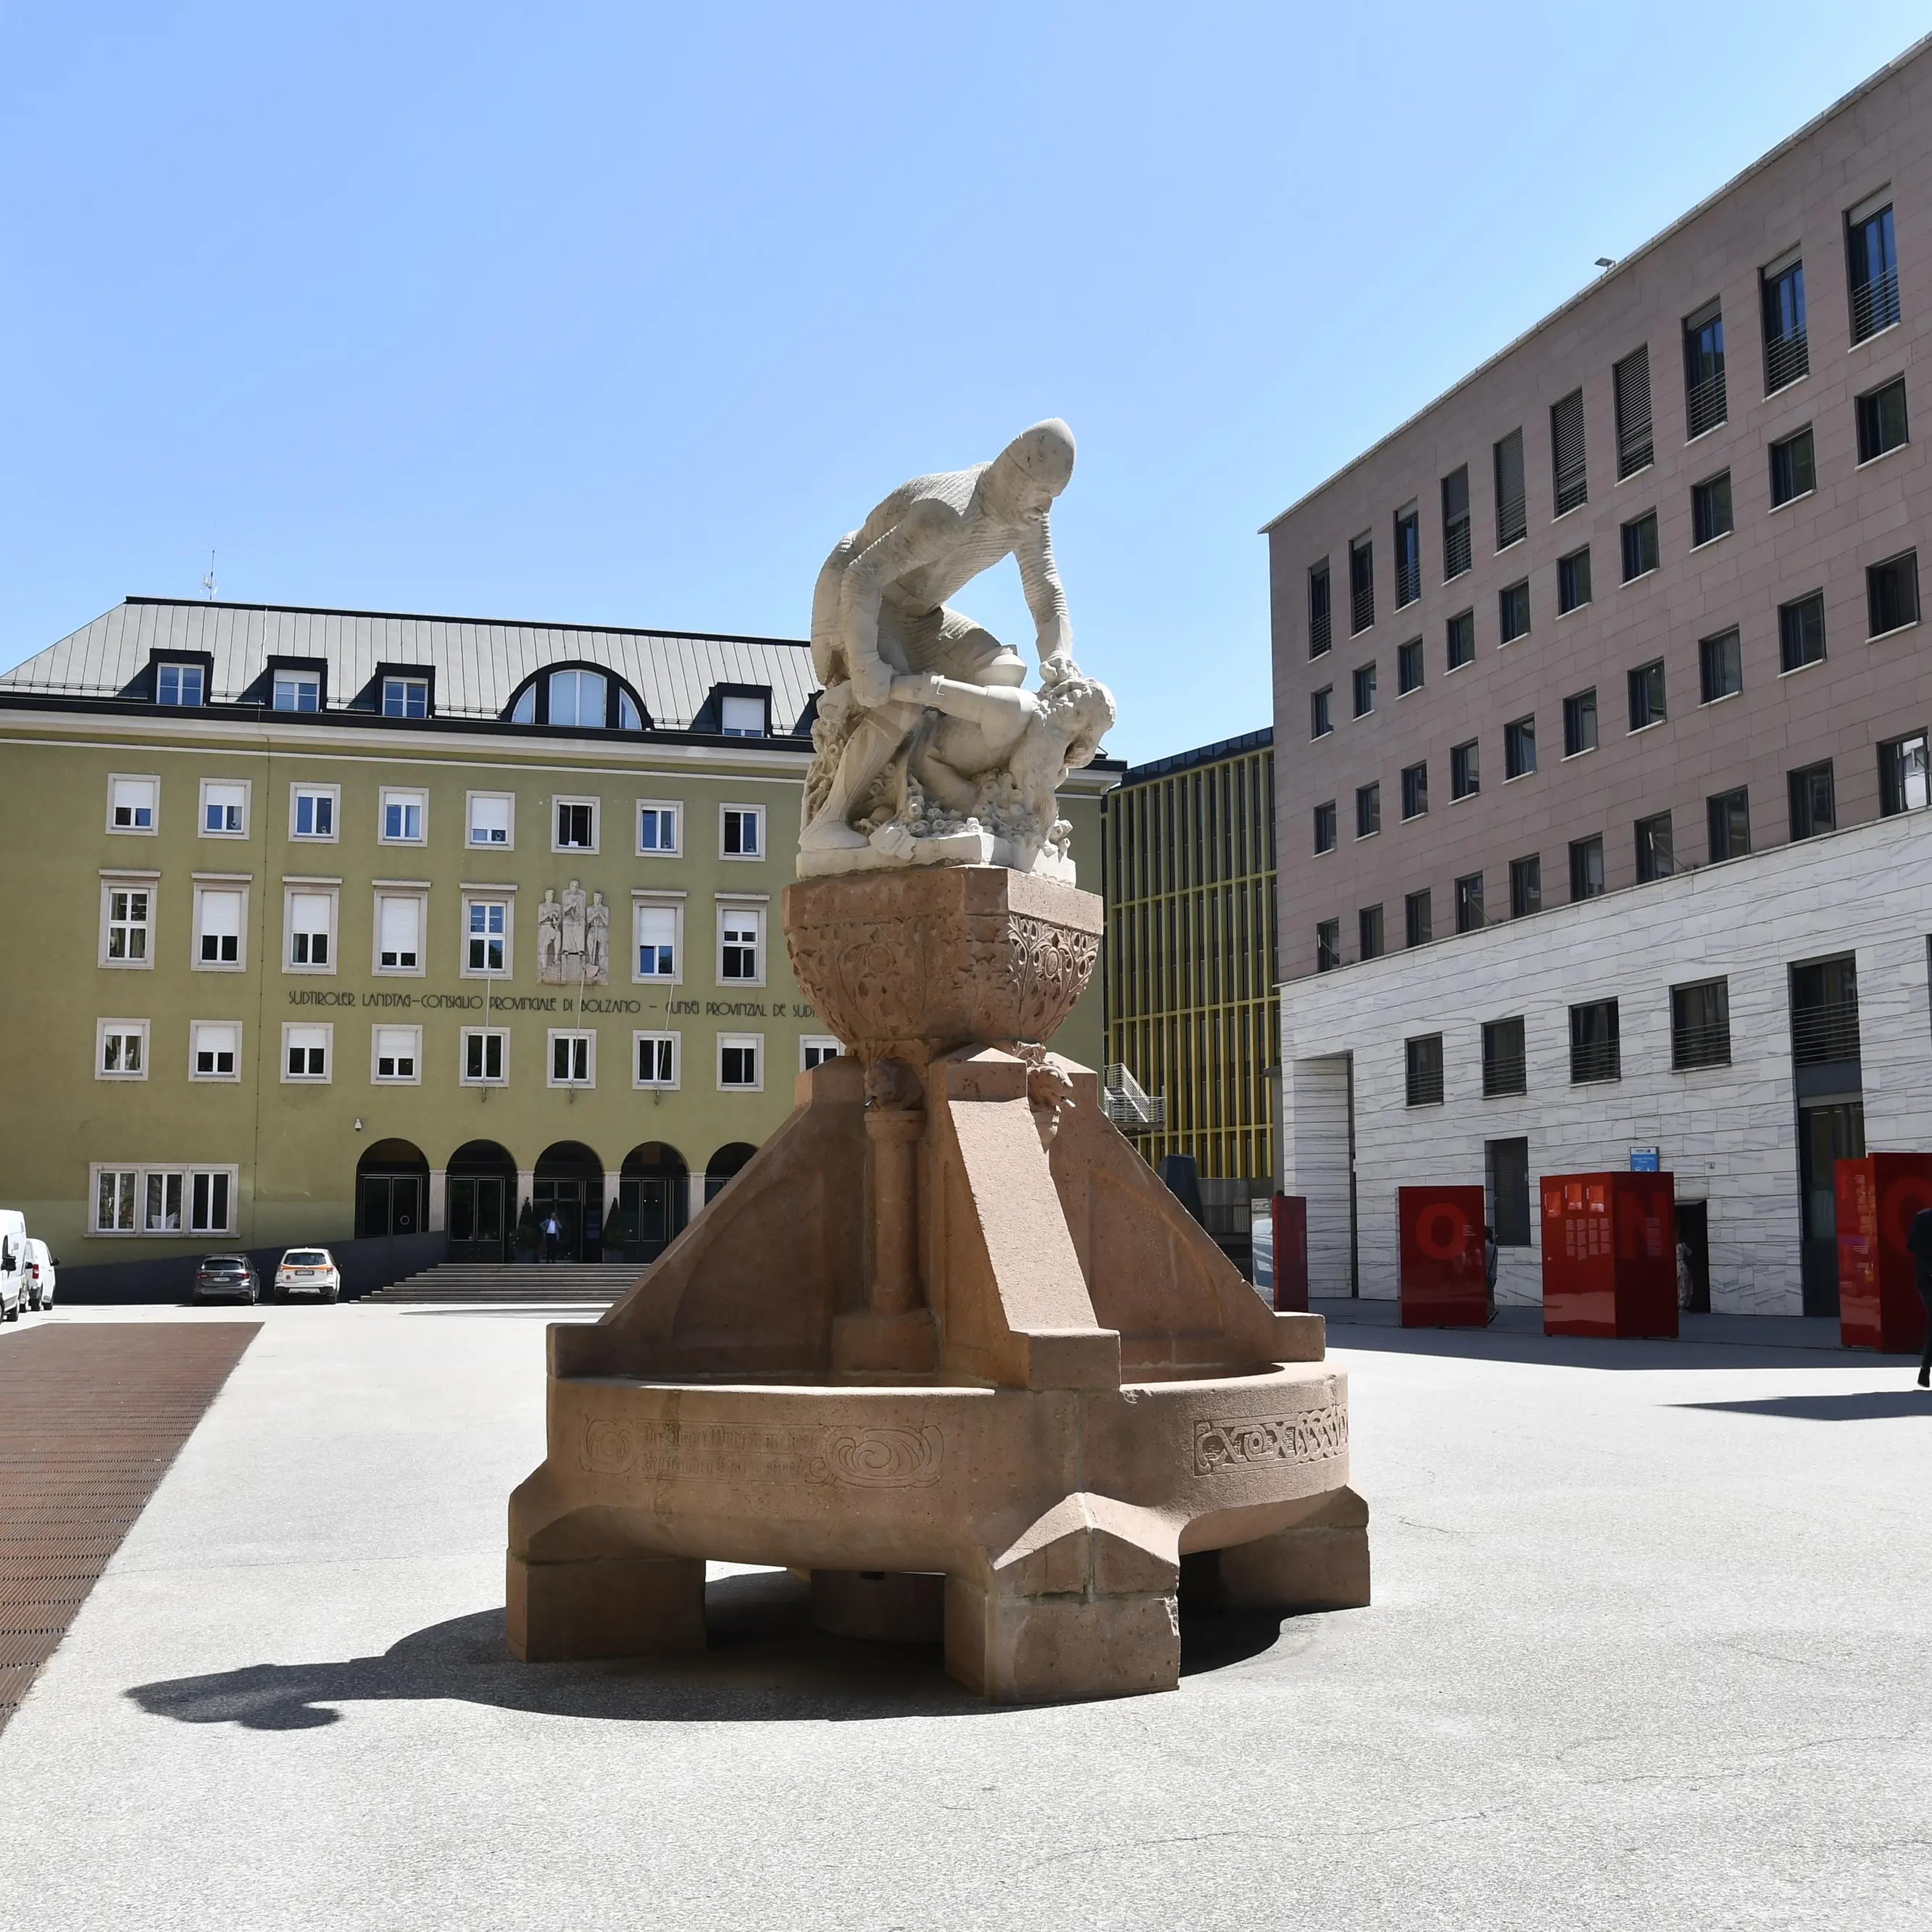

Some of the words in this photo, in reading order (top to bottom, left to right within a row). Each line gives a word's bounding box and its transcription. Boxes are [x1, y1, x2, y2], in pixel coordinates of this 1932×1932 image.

[489, 996, 557, 1012] PROVINCIALE
[563, 999, 572, 1012] DI
[580, 999, 641, 1014] BOLZANO
[773, 1004, 786, 1017] DE
